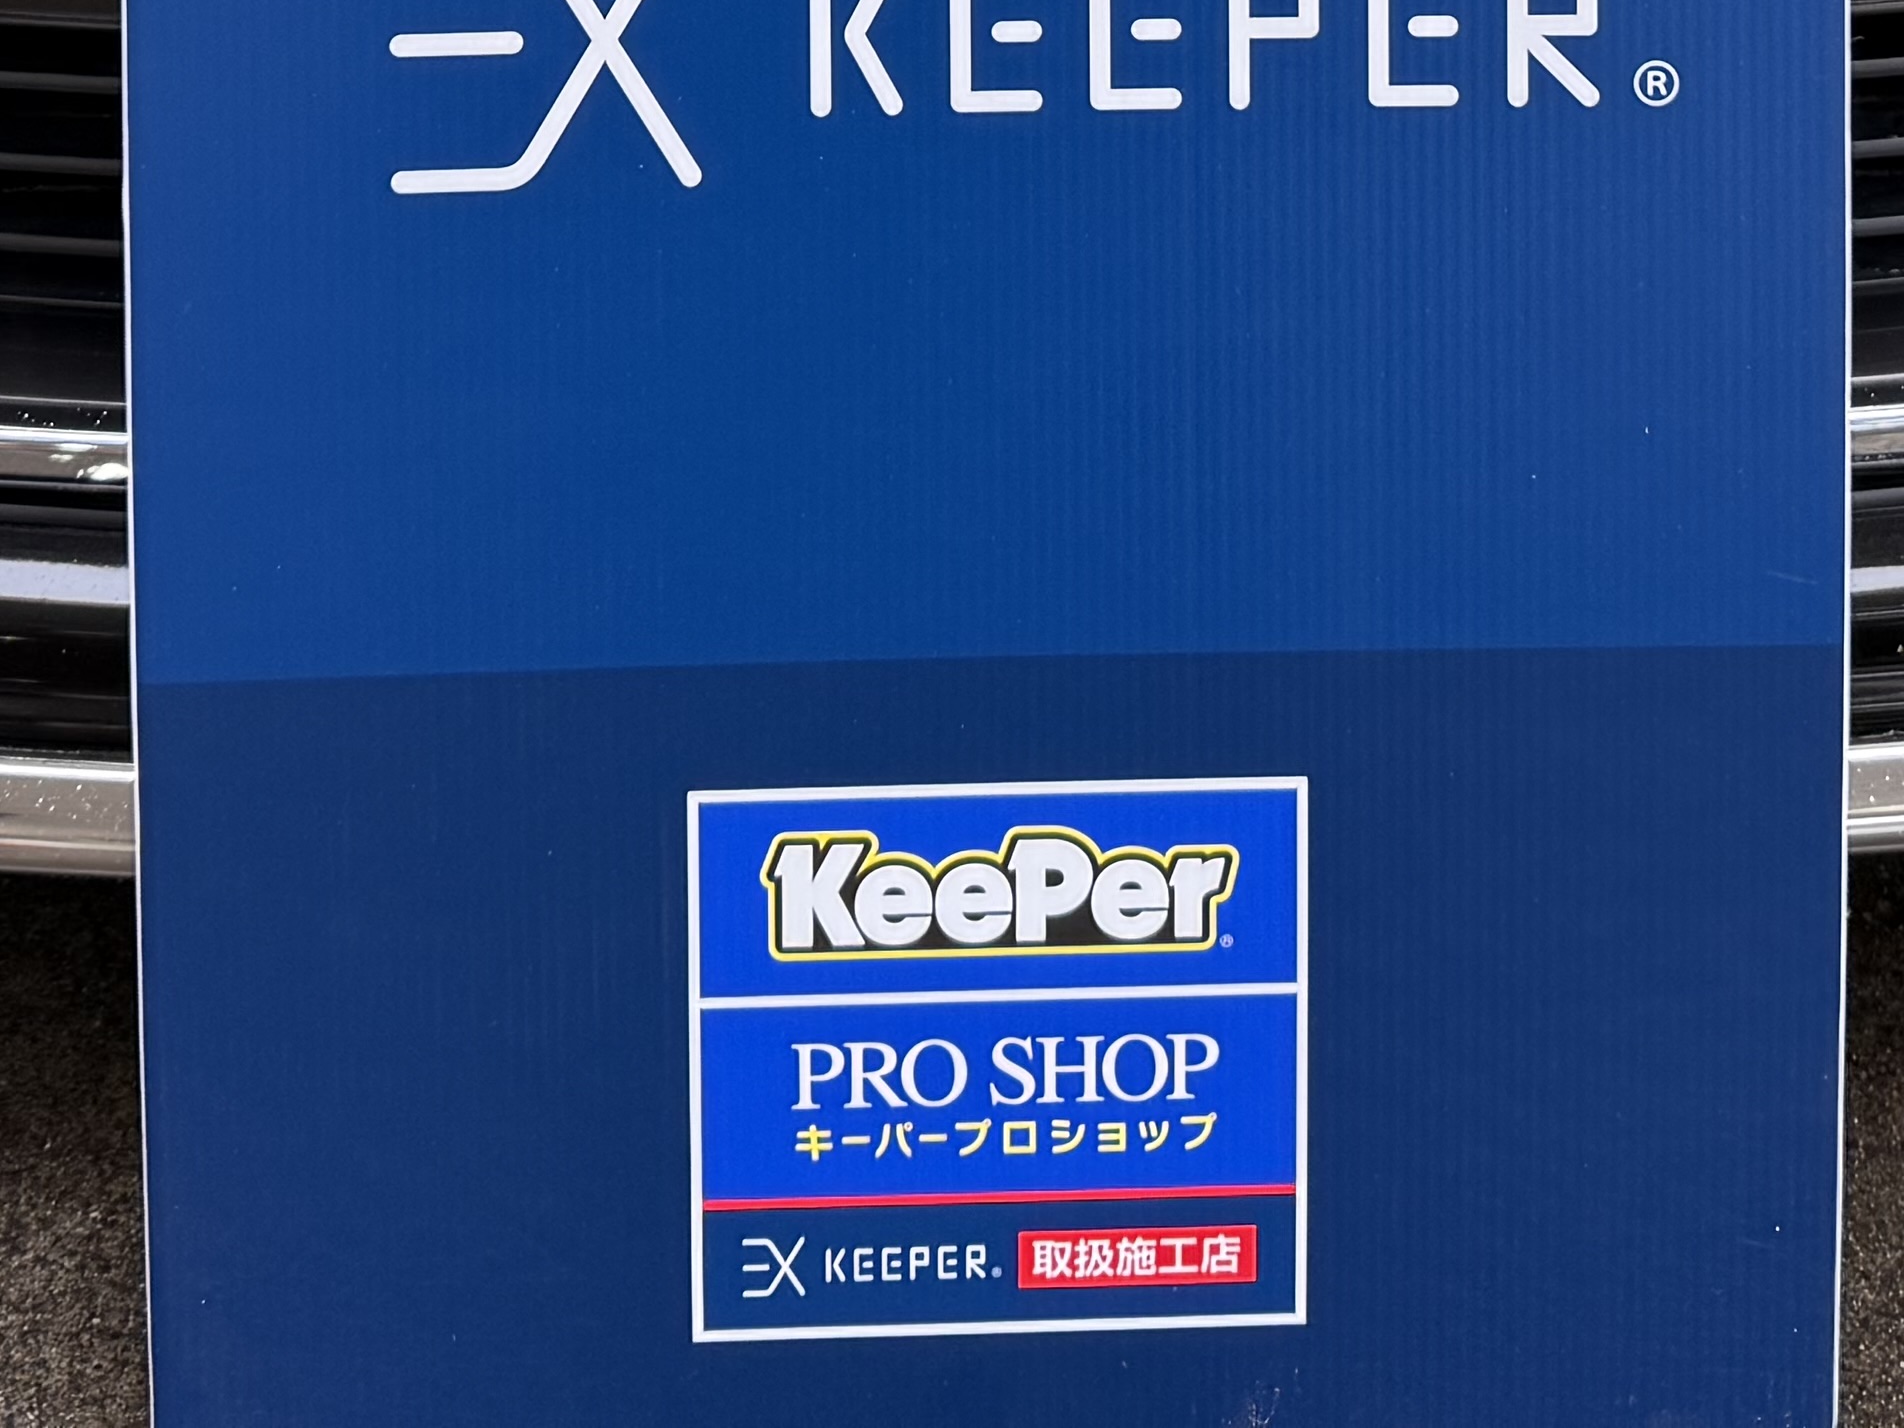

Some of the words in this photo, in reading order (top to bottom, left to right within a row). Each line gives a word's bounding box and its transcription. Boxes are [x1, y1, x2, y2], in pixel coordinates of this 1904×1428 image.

[791, 1038, 968, 1111] PRO
[989, 1032, 1220, 1106] SHOP
[794, 1111, 1218, 1162] キーパープロショップ
[1031, 1233, 1242, 1280] 取扱施工店
